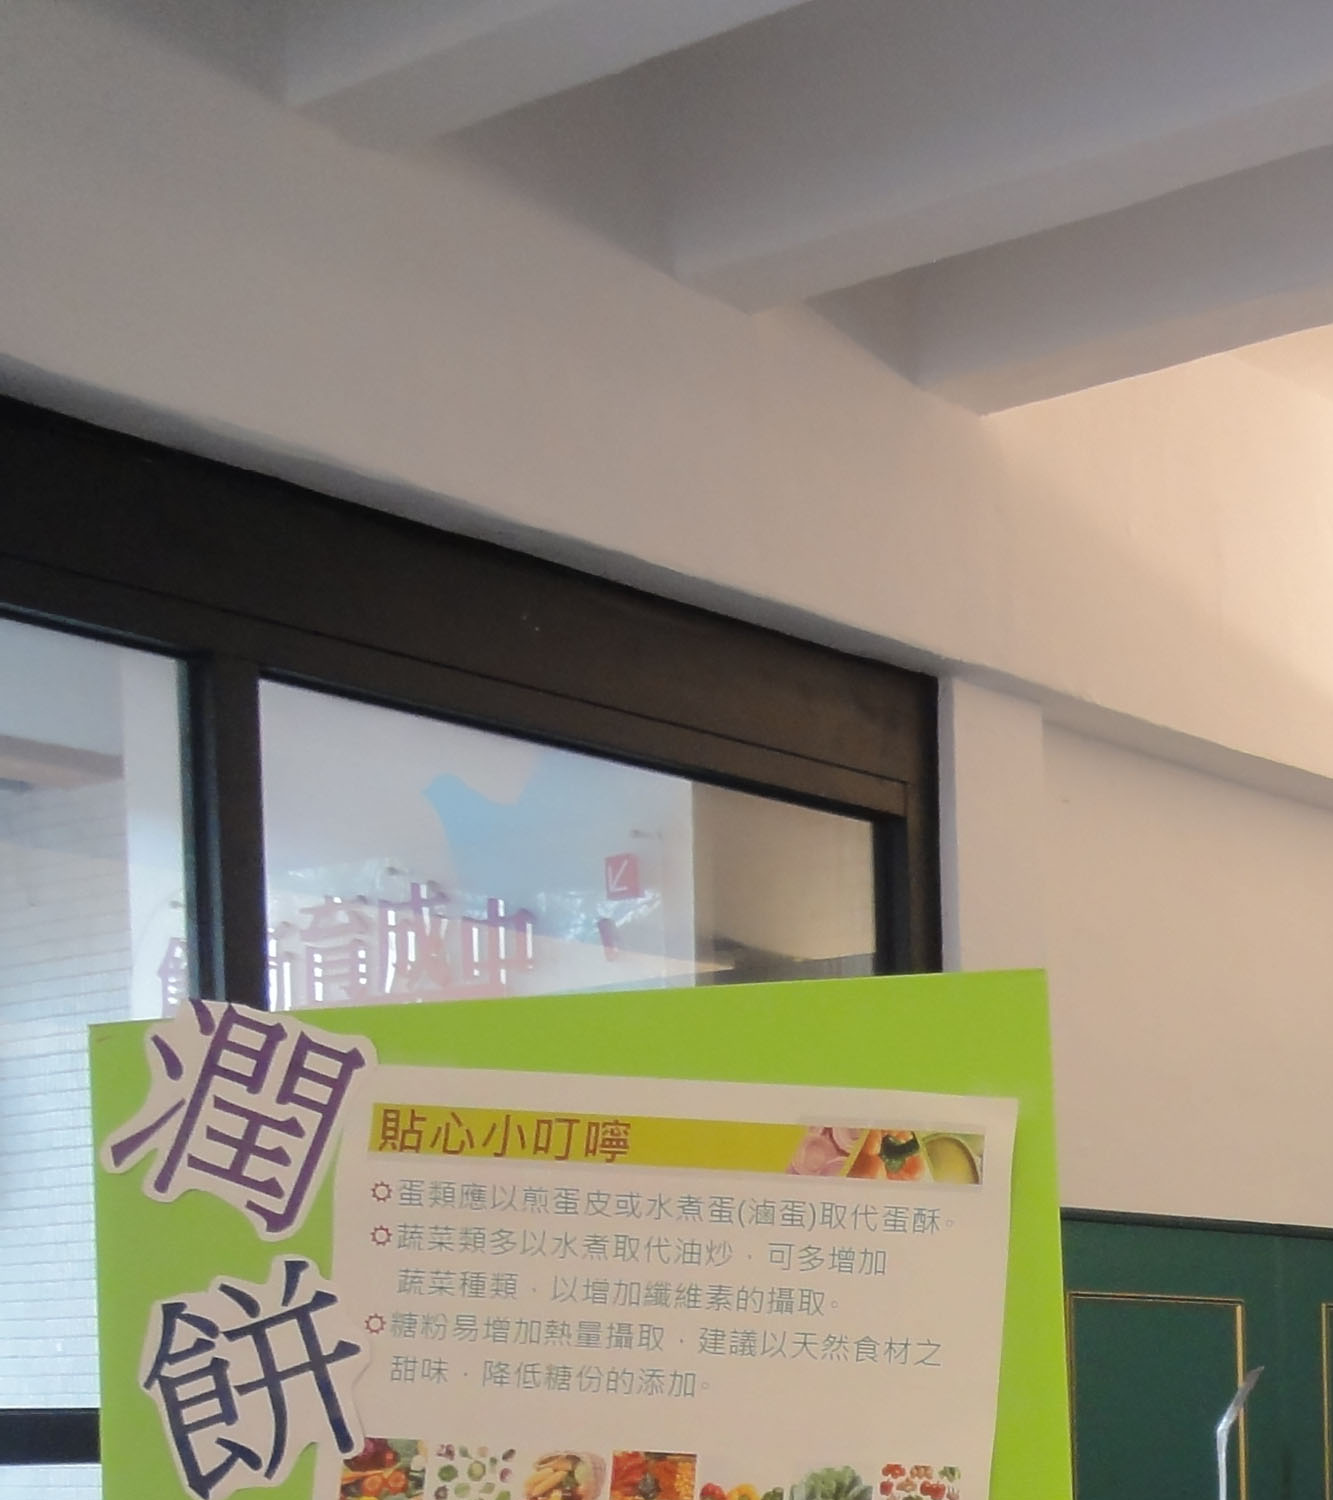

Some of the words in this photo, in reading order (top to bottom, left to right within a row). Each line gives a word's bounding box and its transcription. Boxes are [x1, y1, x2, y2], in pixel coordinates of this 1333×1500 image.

[378, 1107, 632, 1163] 貼心小叮嚀
